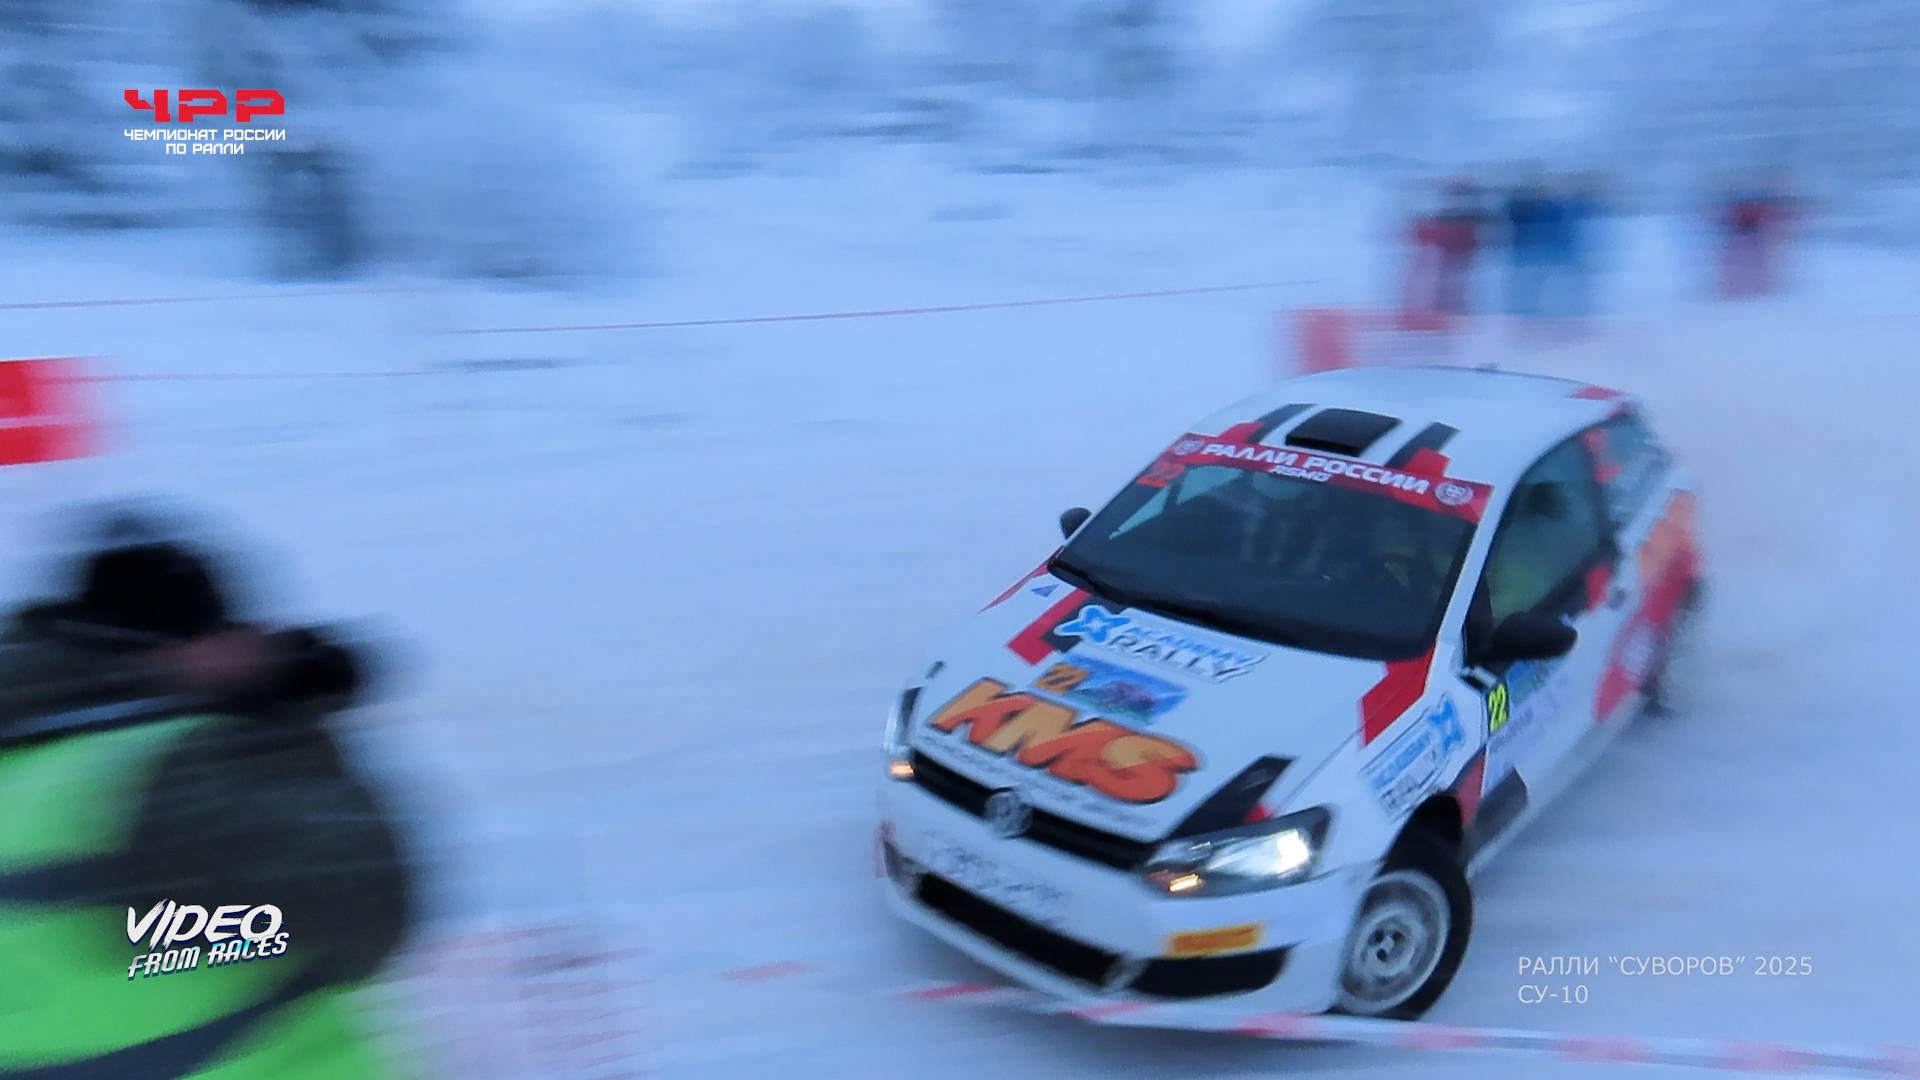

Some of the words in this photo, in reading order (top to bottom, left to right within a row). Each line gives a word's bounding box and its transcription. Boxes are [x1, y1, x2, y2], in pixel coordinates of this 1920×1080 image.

[1201, 443, 1298, 467] РАЛЛИ
[1302, 456, 1431, 495] РОССИИ
[1489, 682, 1506, 734] 22
[931, 677, 1199, 806] KMS
